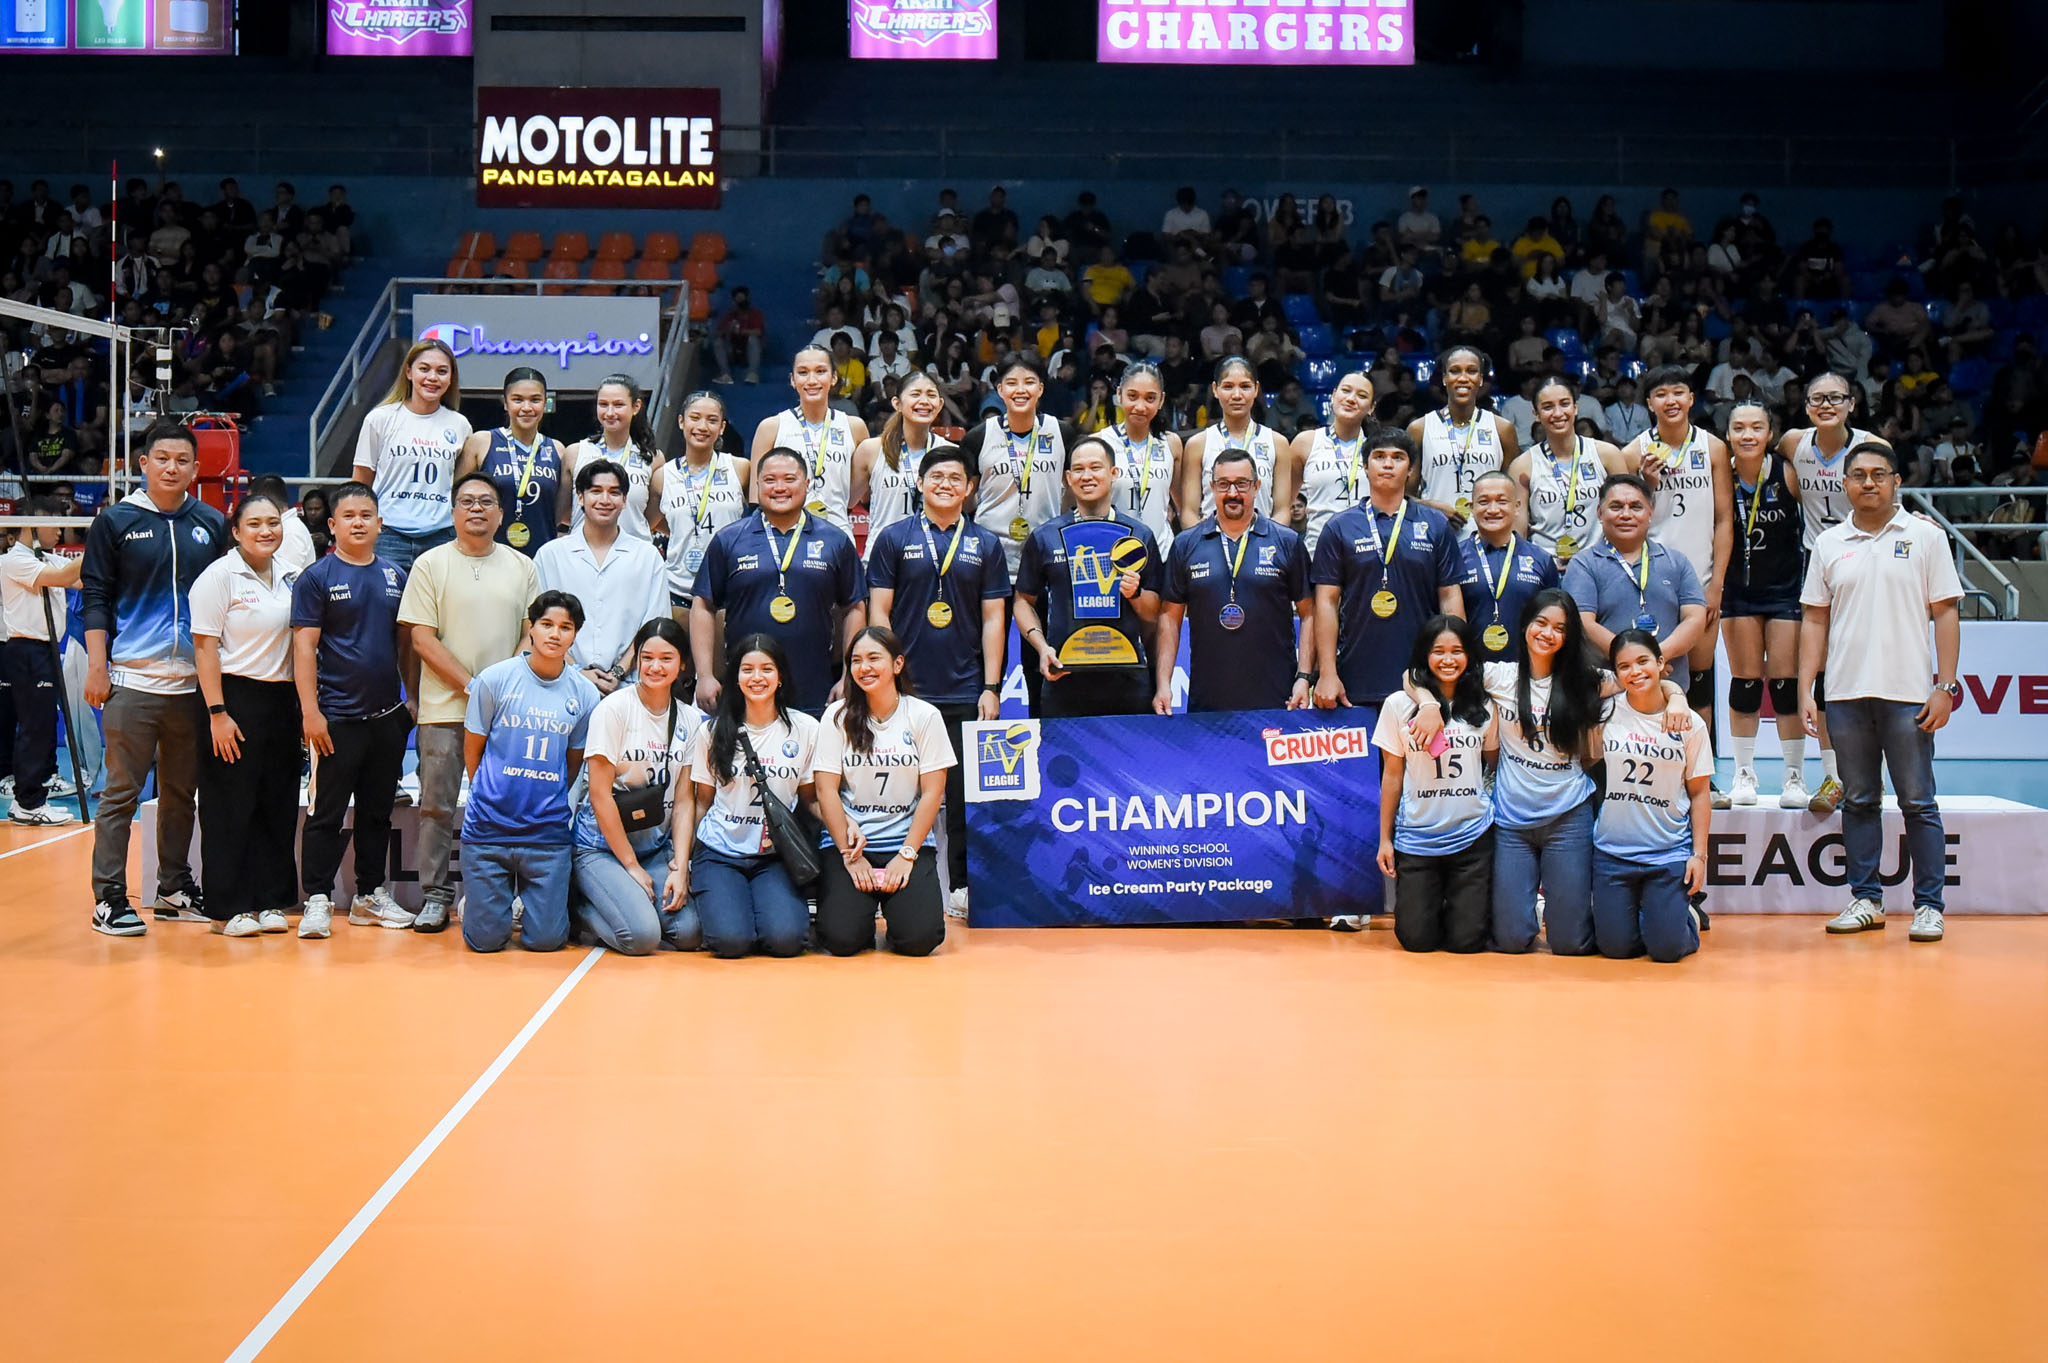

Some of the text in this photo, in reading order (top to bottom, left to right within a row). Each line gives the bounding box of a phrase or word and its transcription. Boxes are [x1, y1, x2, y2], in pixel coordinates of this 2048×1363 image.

[345, 3, 460, 30] CHARGERS
[869, 6, 984, 33] CHARGERS
[1106, 11, 1404, 52] CHARGERS
[480, 115, 713, 166] MOTOLITE
[482, 169, 715, 187] PANGMATAGALAN
[417, 322, 653, 369] Champion
[411, 437, 439, 447] Akari
[410, 462, 438, 485] 10
[493, 464, 557, 482] ADSON
[991, 460, 1057, 476] ADSON
[1817, 469, 1837, 478] Akari
[1335, 477, 1360, 501] 21
[1454, 469, 1475, 494] 13
[1655, 476, 1710, 492] DAMSON
[1800, 478, 1845, 493] ADAMS
[670, 490, 735, 510] ADSON
[1128, 488, 1151, 511] 17
[1673, 493, 1686, 517] 3
[1823, 496, 1831, 517] 1
[125, 529, 153, 541] Akari
[903, 551, 924, 560] Akari
[737, 561, 758, 571] Akari
[1191, 569, 1210, 579] Akari
[330, 590, 352, 601] Akari
[1078, 596, 1115, 608] LEAGUE
[527, 706, 558, 718] Akari
[647, 740, 667, 750] Akar
[1270, 730, 1363, 761] CRUNCH
[1627, 732, 1657, 744] Akari
[522, 735, 549, 762] 11
[622, 749, 684, 763] ADMSO
[1603, 740, 1684, 761] ADAMSON
[760, 756, 775, 764] ari
[842, 754, 920, 767] ADAMSON
[1433, 754, 1463, 779] 15
[1508, 754, 1572, 771] ADY FALCONS
[984, 775, 1020, 787] LEAGUE
[1622, 759, 1654, 786] 22
[874, 772, 889, 796] 7
[1418, 789, 1439, 798] LADY
[1604, 792, 1670, 808] LADY FALCONS
[725, 814, 744, 825] LADY
[1050, 789, 1307, 833] CHAMPION
[1128, 843, 1230, 856] WINNING SCHOOL
[1127, 856, 1233, 870] WOMEN'S DIVISION
[1706, 833, 1961, 887] EAGU
[1089, 878, 1273, 896] Ice Cream Party Package
